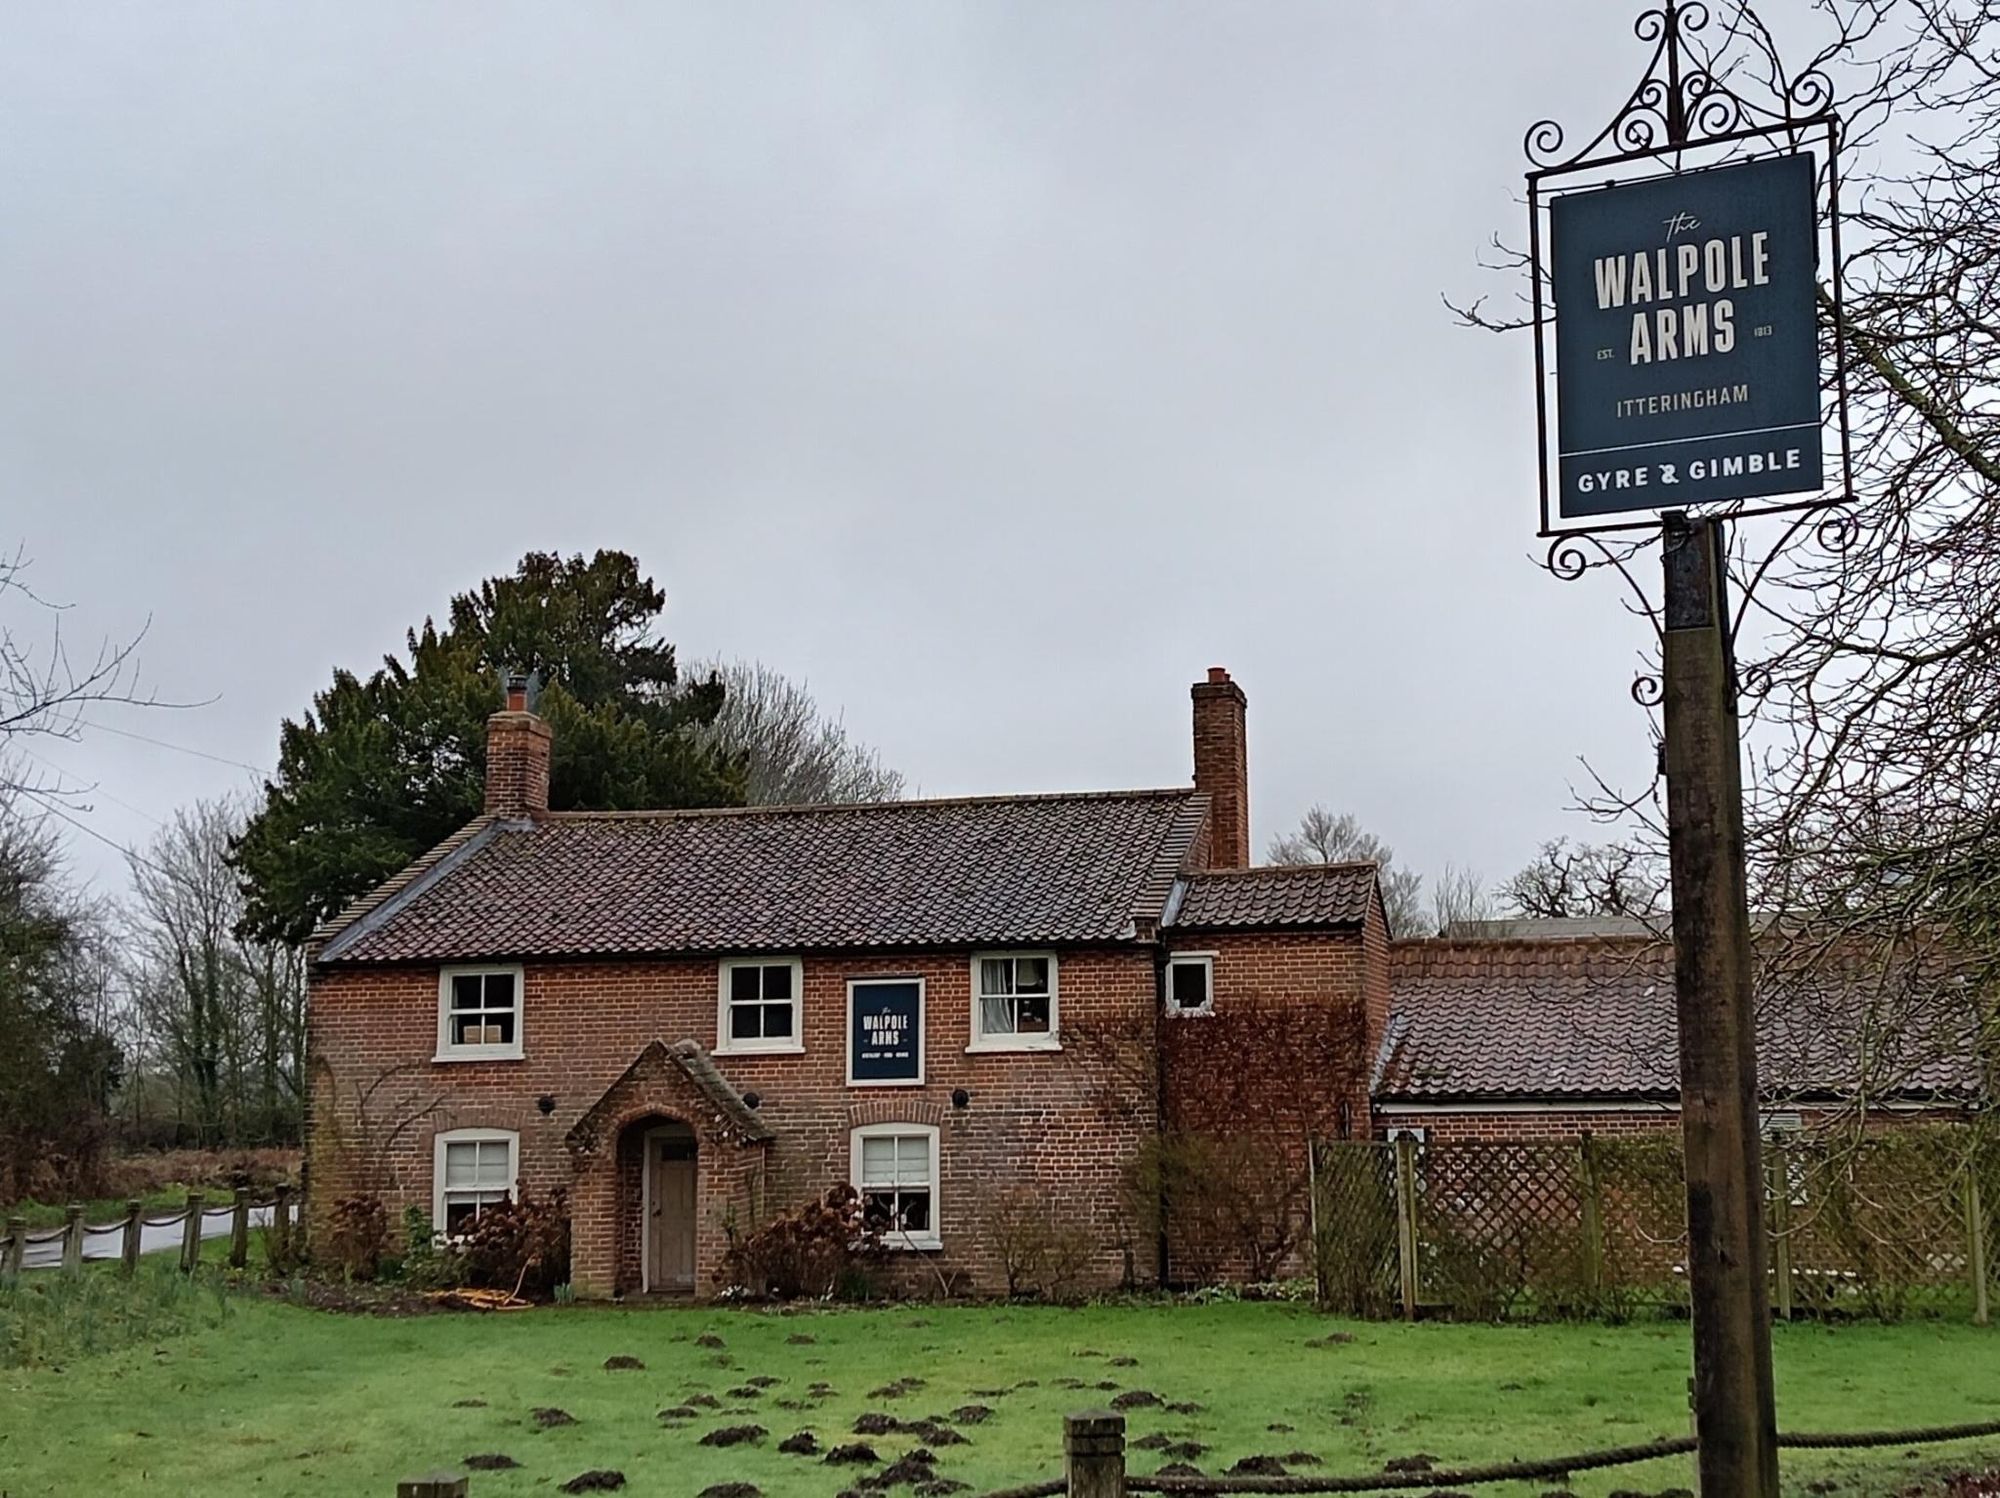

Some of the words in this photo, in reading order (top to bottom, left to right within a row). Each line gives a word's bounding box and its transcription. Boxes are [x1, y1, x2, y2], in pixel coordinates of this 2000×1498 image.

[1662, 212, 1701, 242] the
[1594, 231, 1769, 310] WALPOLE
[1630, 299, 1735, 365] ARMS
[1617, 384, 1748, 418] ITTERINGHAM
[1578, 467, 1648, 492] GYRE
[1659, 464, 1679, 484] &
[1689, 449, 1800, 480] GIMBLE
[863, 1015, 908, 1030] WALPOLE
[871, 1031, 899, 1046] ARMS
